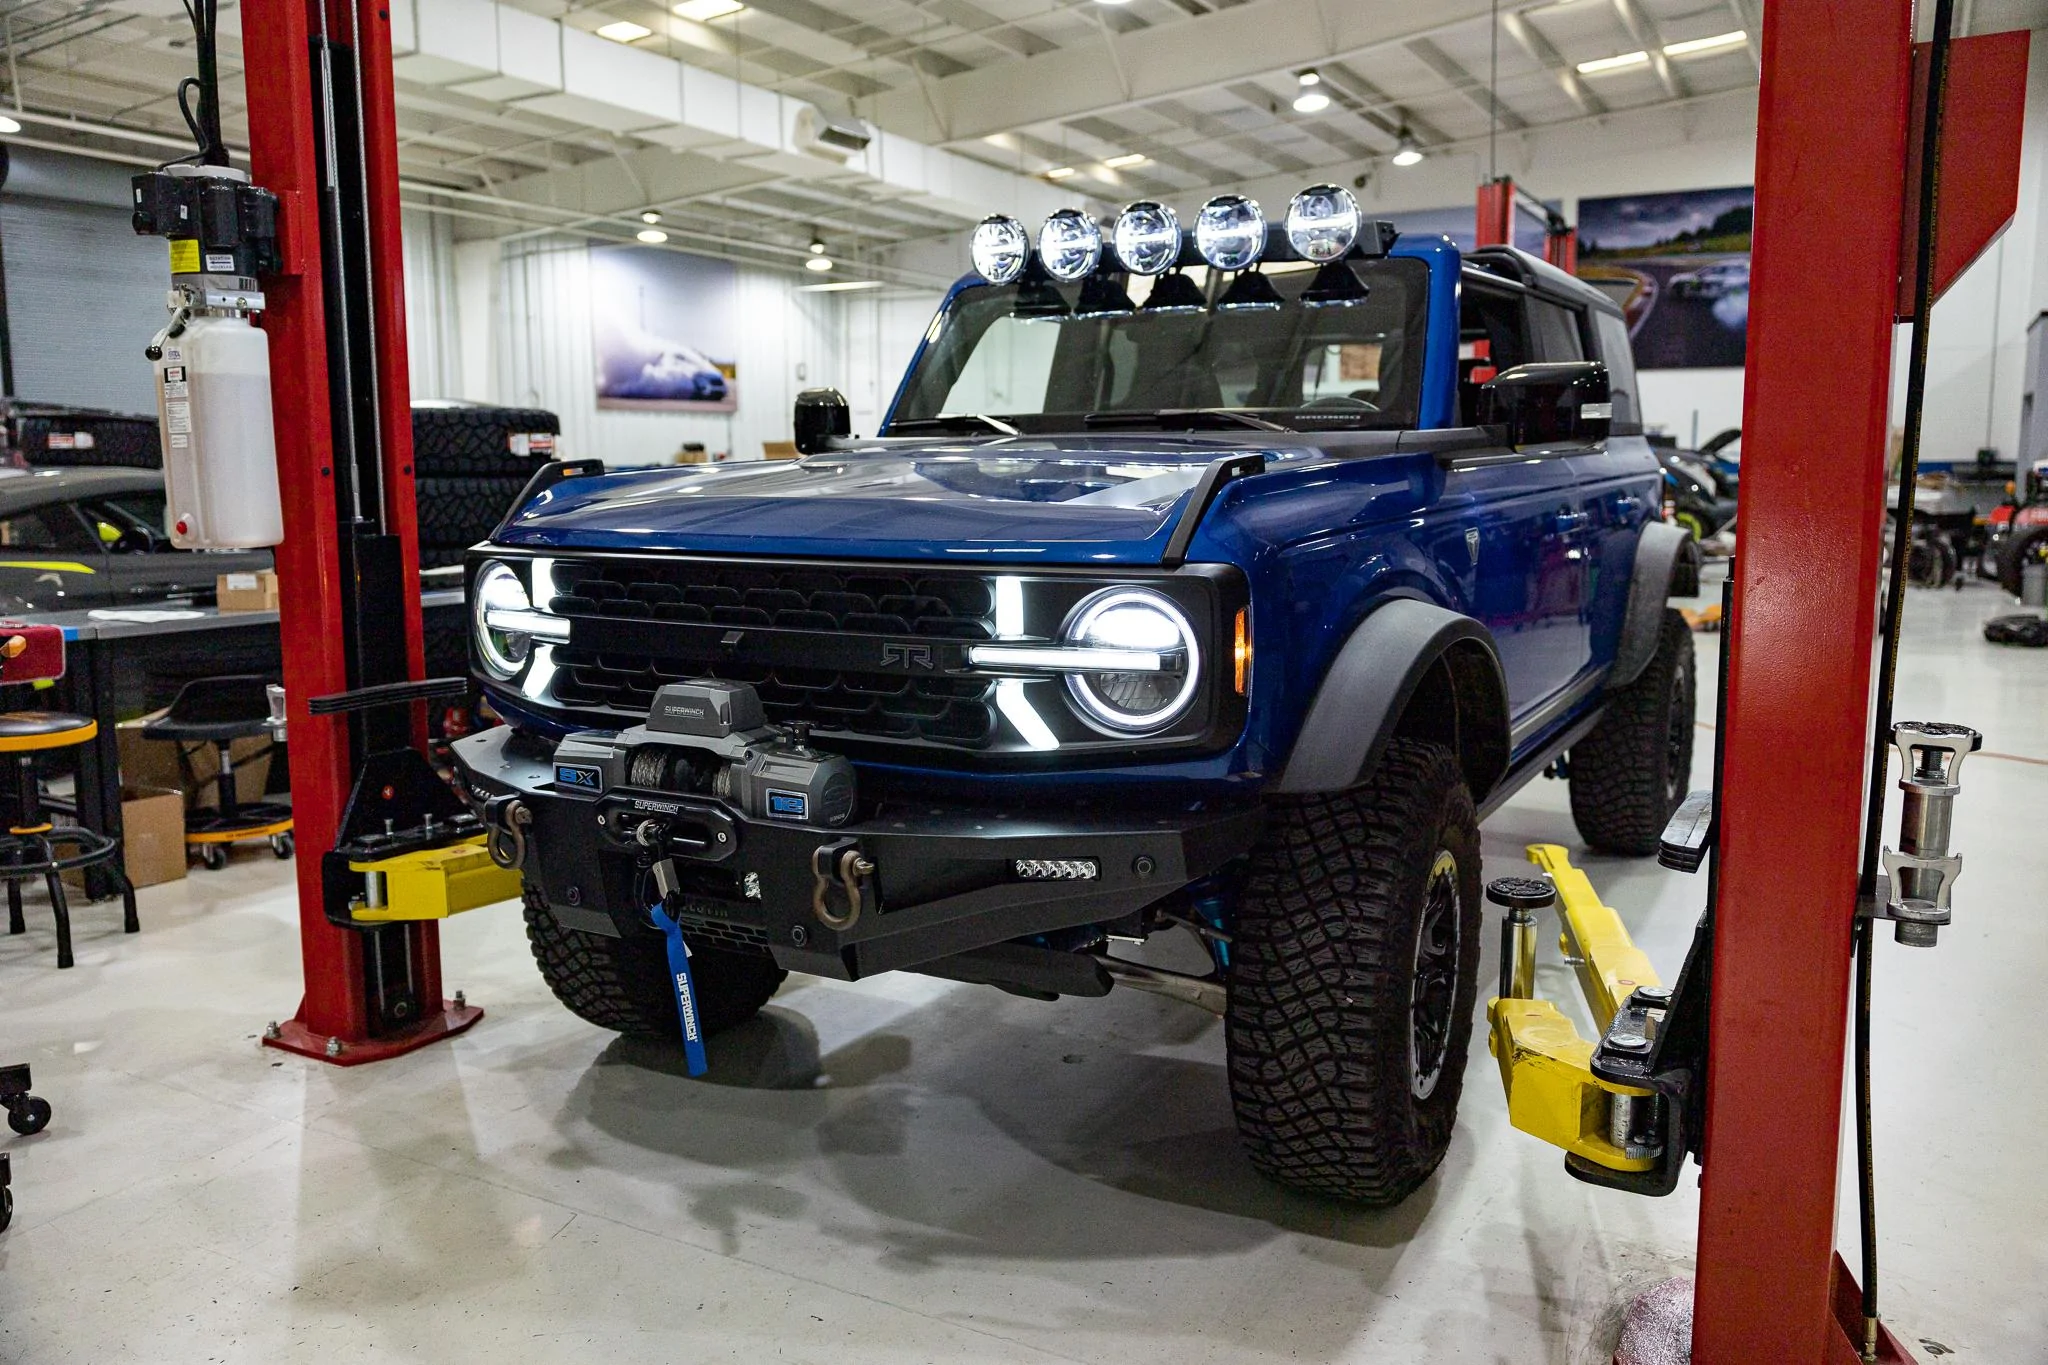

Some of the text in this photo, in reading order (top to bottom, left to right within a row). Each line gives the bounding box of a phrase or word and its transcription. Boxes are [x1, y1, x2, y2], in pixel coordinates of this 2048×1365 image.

[664, 705, 705, 717] SUPERWINCH
[634, 800, 679, 813] SUPERWINCH
[676, 972, 698, 1042] SUPERWINCH
